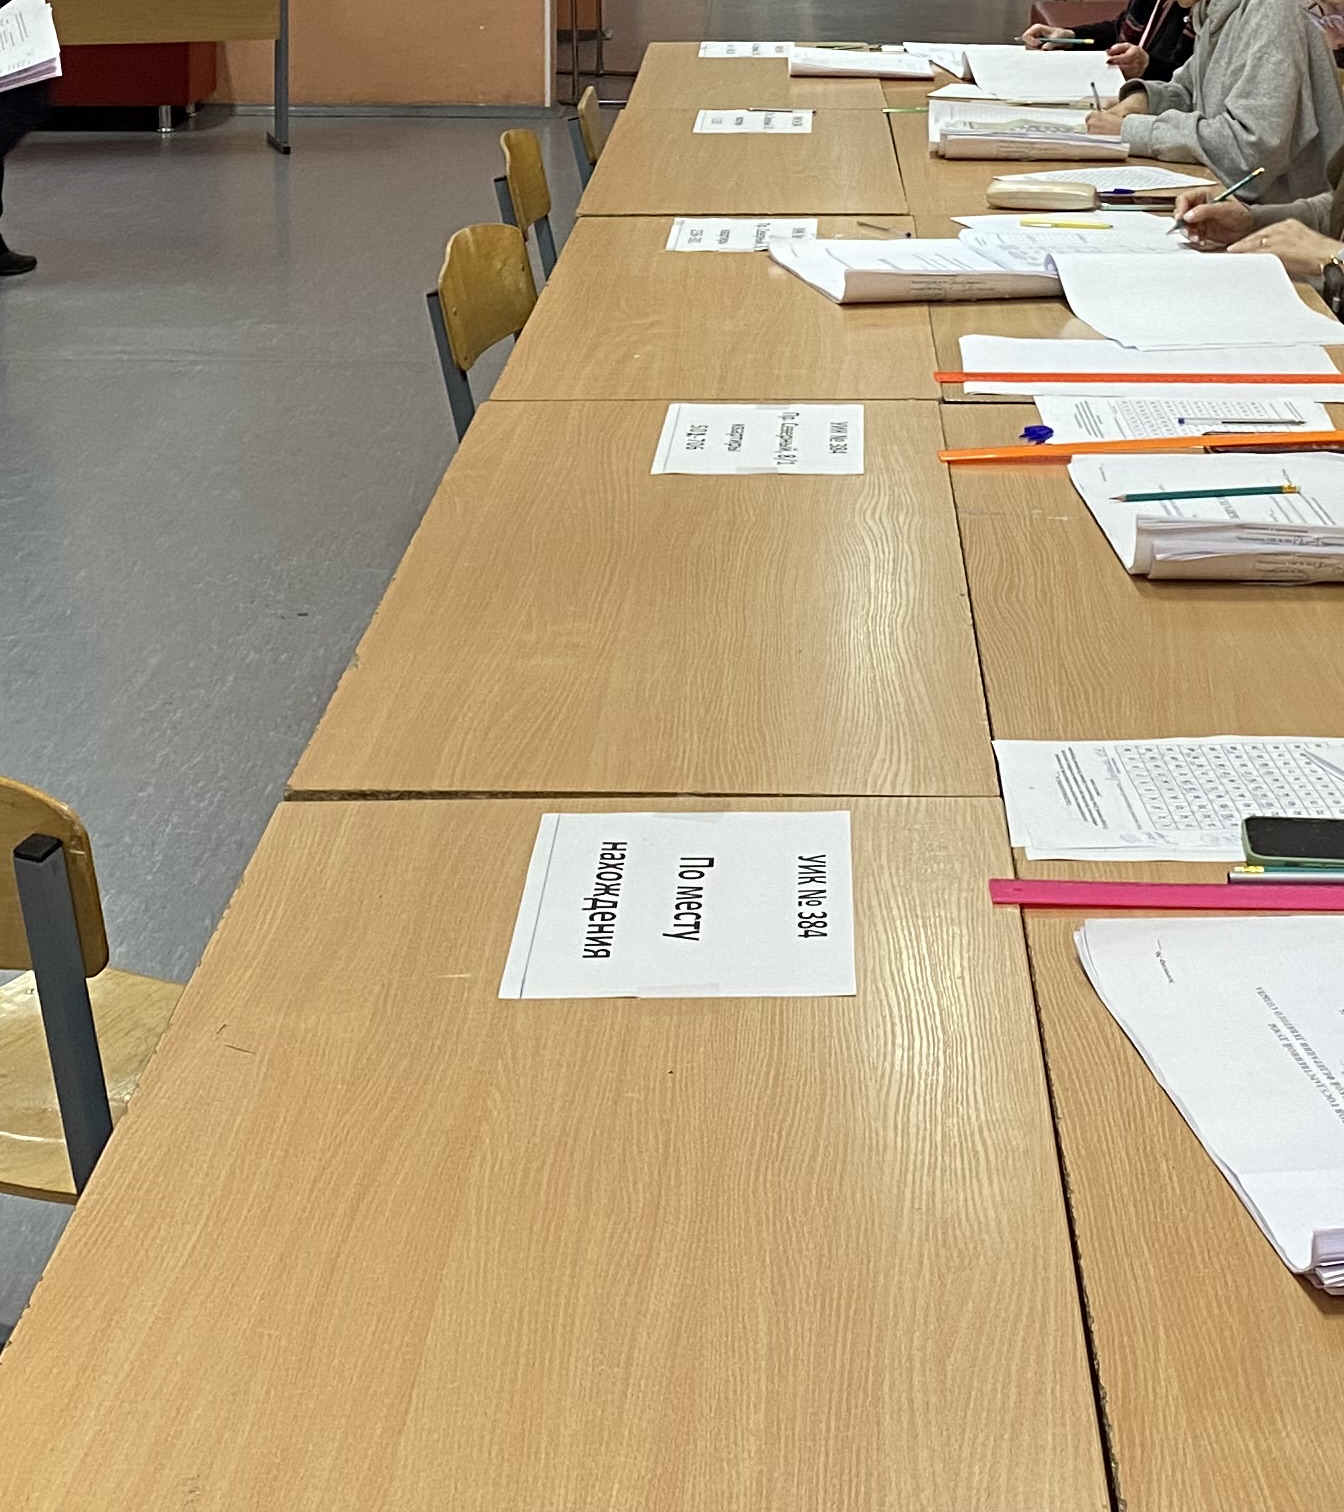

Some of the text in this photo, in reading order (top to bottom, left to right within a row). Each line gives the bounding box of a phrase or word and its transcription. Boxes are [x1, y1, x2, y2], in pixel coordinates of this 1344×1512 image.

[581, 841, 628, 959] нахождения
[662, 857, 715, 941] По месту
[797, 854, 827, 939] УИК № 384
